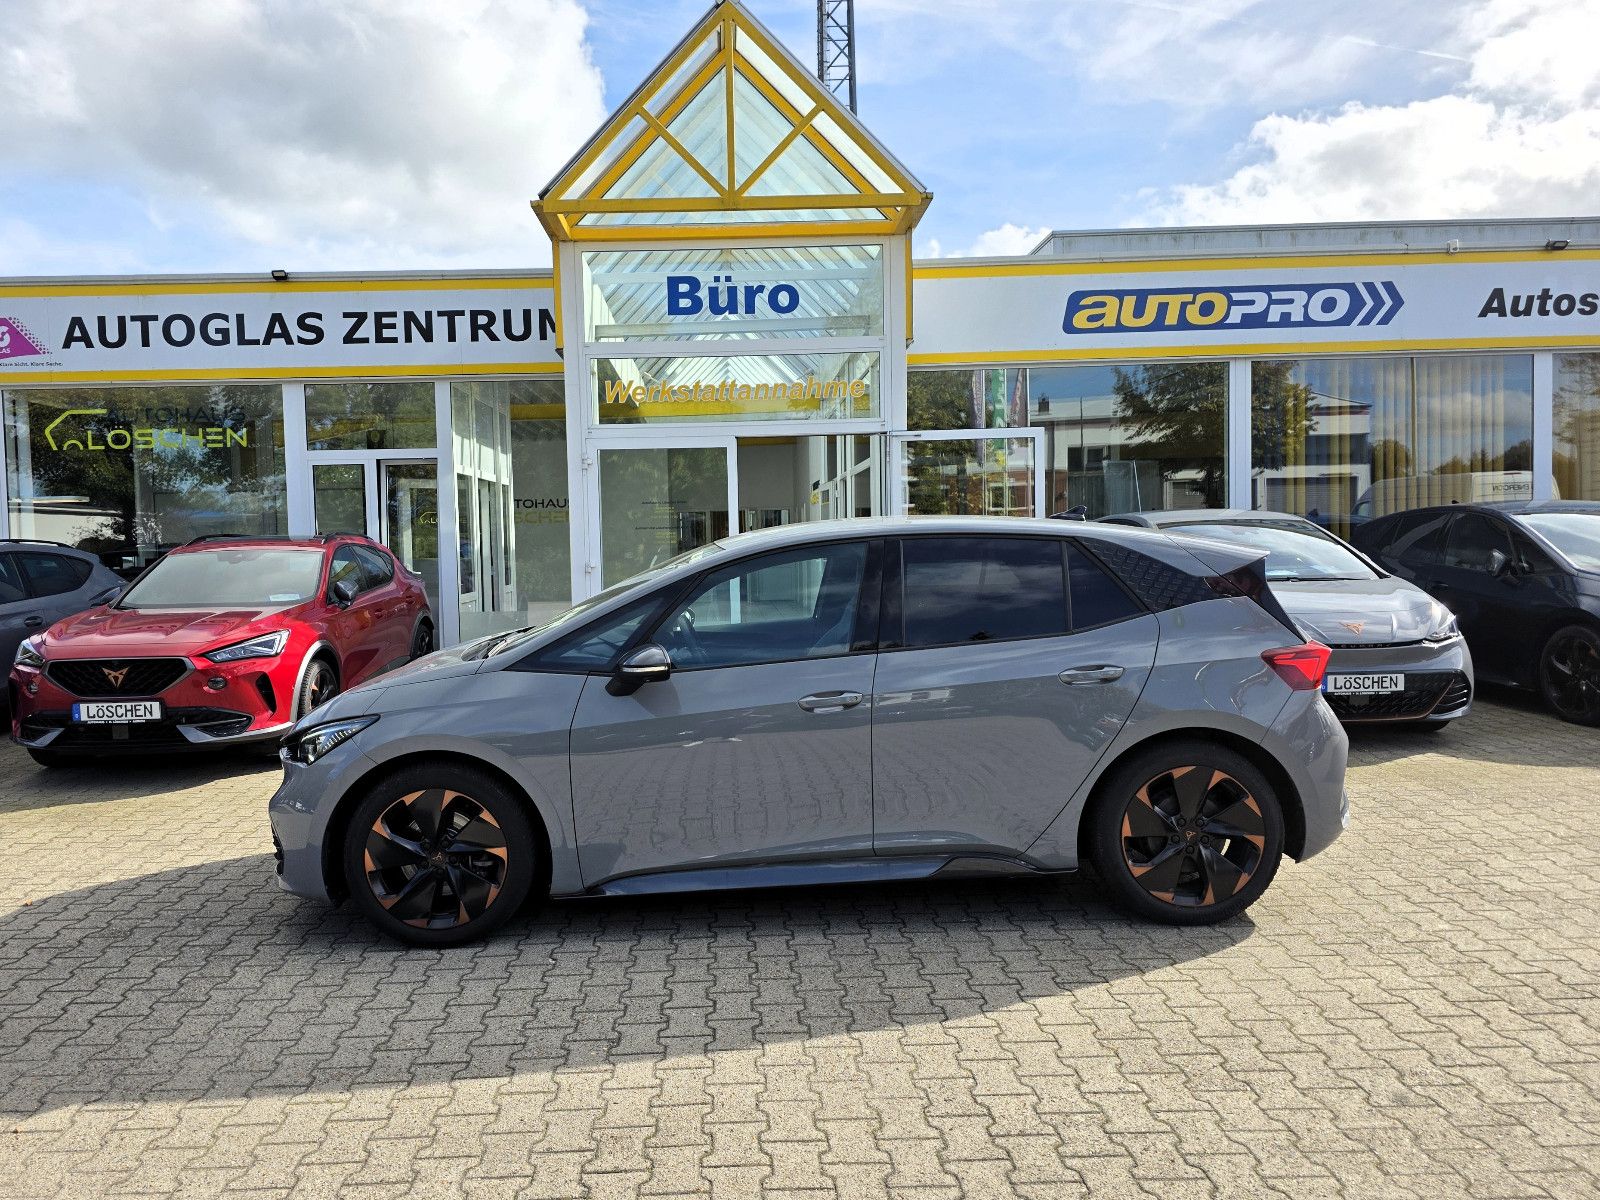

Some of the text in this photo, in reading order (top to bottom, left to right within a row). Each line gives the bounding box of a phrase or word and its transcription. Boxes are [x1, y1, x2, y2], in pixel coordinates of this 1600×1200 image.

[666, 275, 800, 316] Büro
[1478, 287, 1600, 318] Autos
[62, 312, 325, 350] AUTOGLAS
[604, 376, 866, 405] Werkstattannahme
[87, 425, 247, 450] LÖSCHEN
[514, 498, 570, 509] TOHAU
